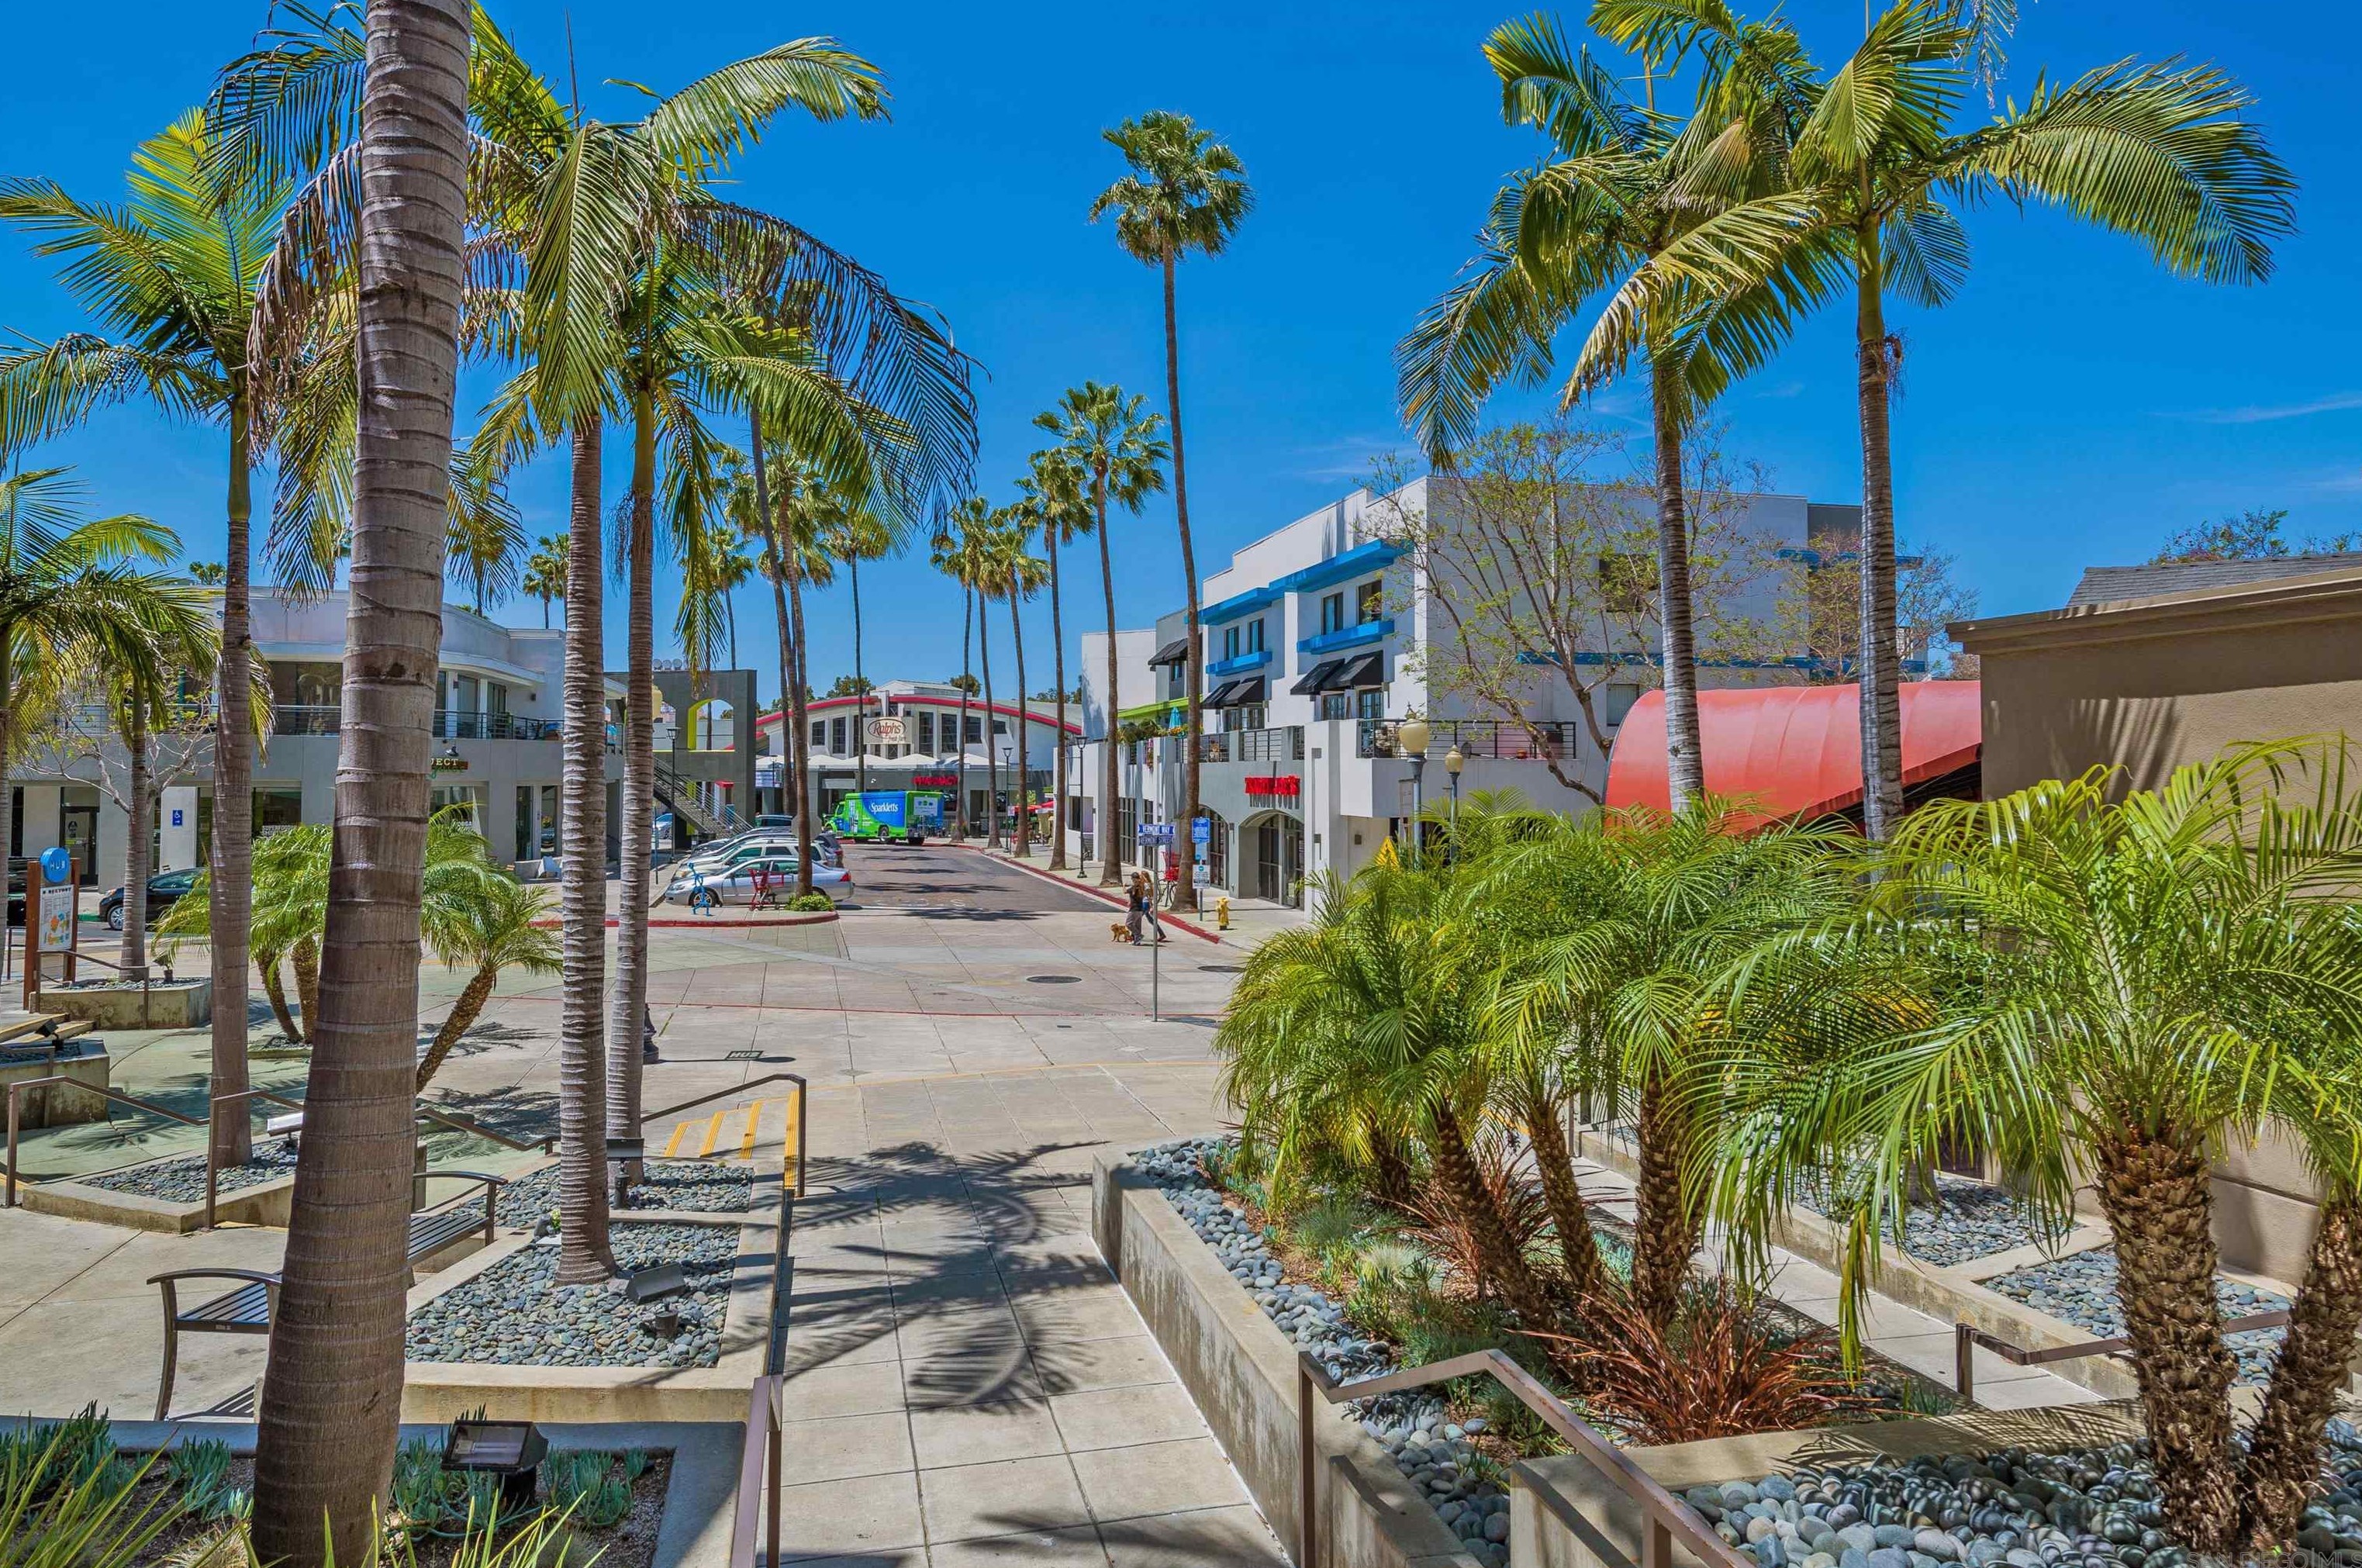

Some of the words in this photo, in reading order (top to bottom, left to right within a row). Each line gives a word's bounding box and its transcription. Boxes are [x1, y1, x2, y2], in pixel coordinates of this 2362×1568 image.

[873, 722, 901, 736] Ralphs
[870, 802, 899, 814] Sparkletts
[50, 860, 65, 869] HUB
